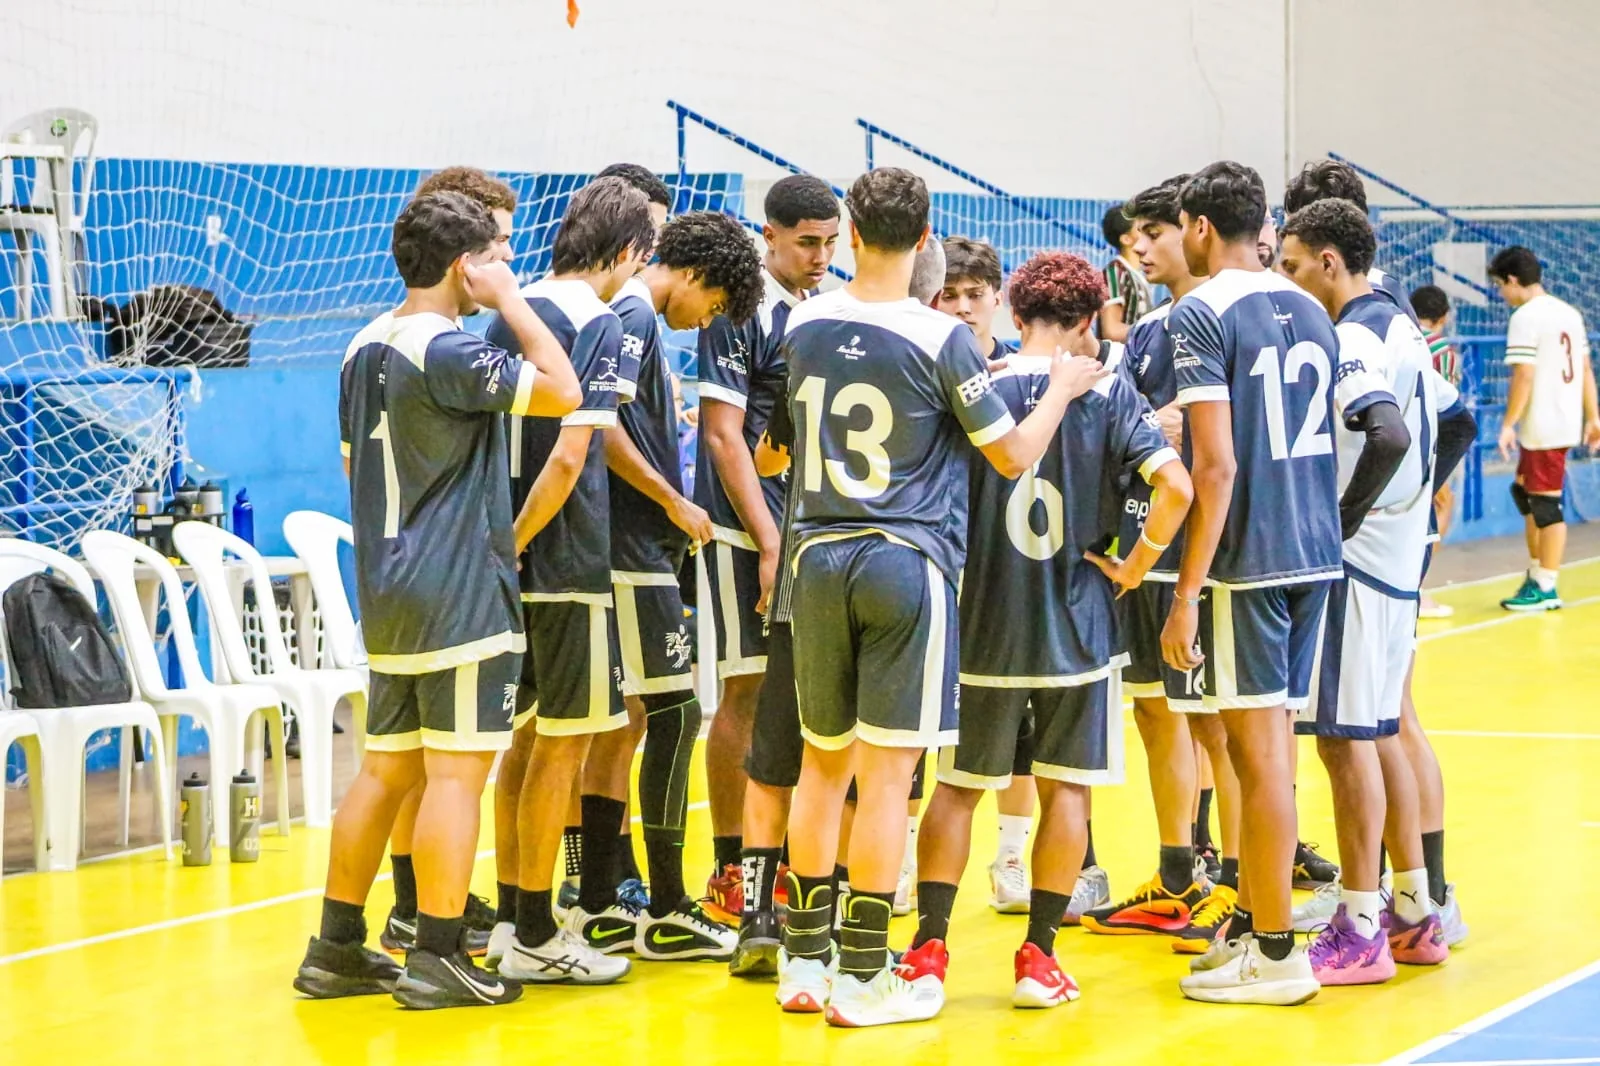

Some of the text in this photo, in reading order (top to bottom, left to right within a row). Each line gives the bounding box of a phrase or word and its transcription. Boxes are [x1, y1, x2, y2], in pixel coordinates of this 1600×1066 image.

[1250, 341, 1333, 461] 12
[1559, 331, 1574, 384] 3
[369, 410, 401, 538] 1
[795, 375, 893, 499] 13
[1005, 446, 1064, 561] 6
